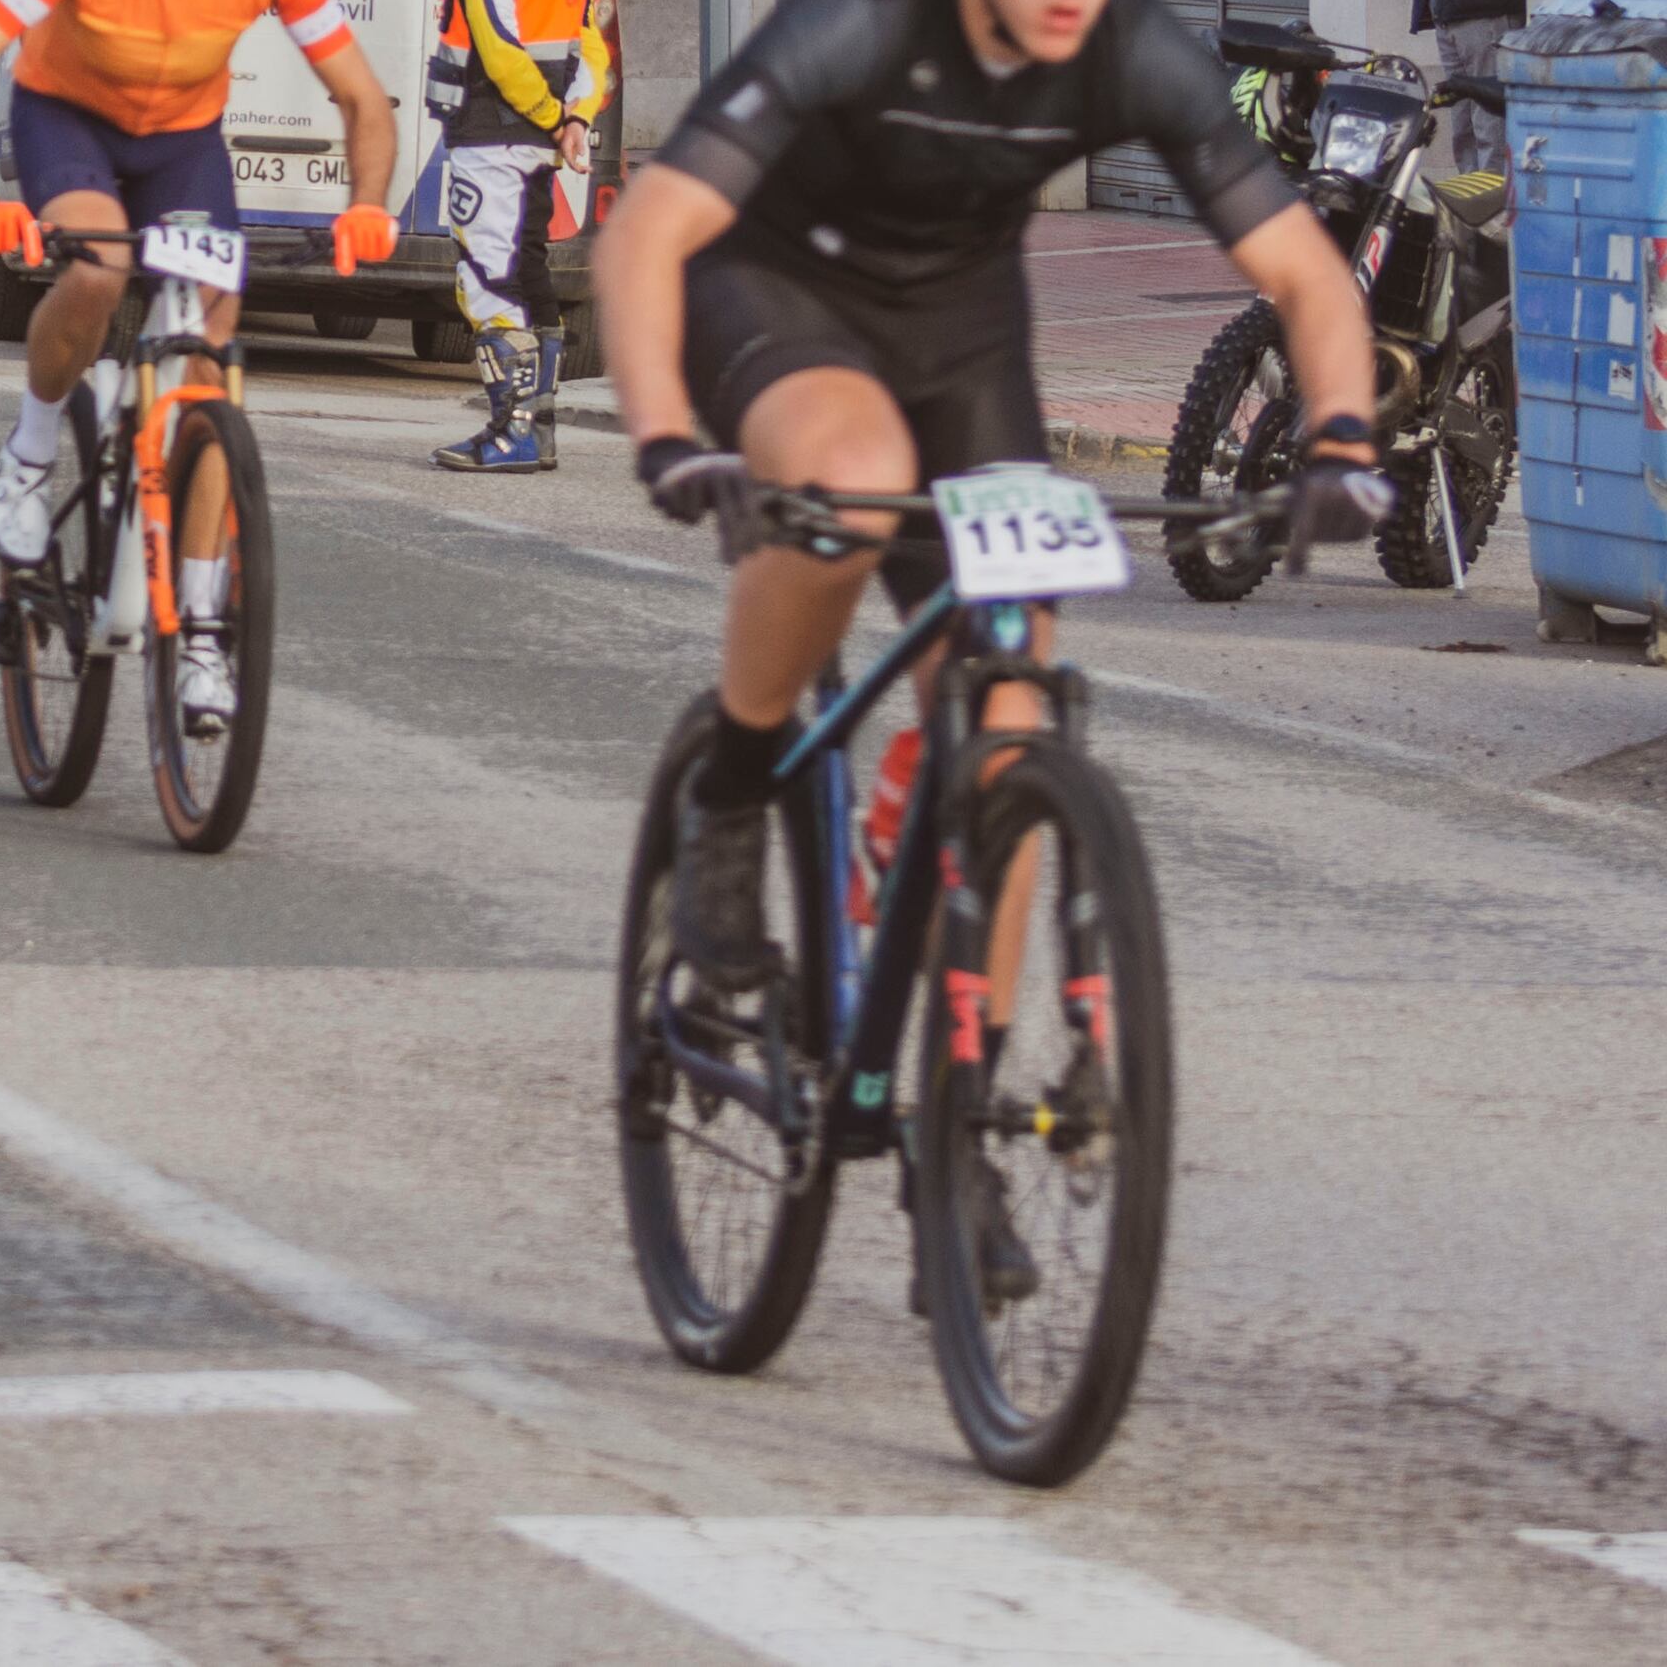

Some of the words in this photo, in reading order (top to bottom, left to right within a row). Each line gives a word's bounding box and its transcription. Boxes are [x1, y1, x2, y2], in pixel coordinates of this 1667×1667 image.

[223, 110, 312, 127] .paher.com
[234, 156, 285, 182] 043
[160, 225, 234, 265] 1143
[967, 511, 1102, 555] 1135
